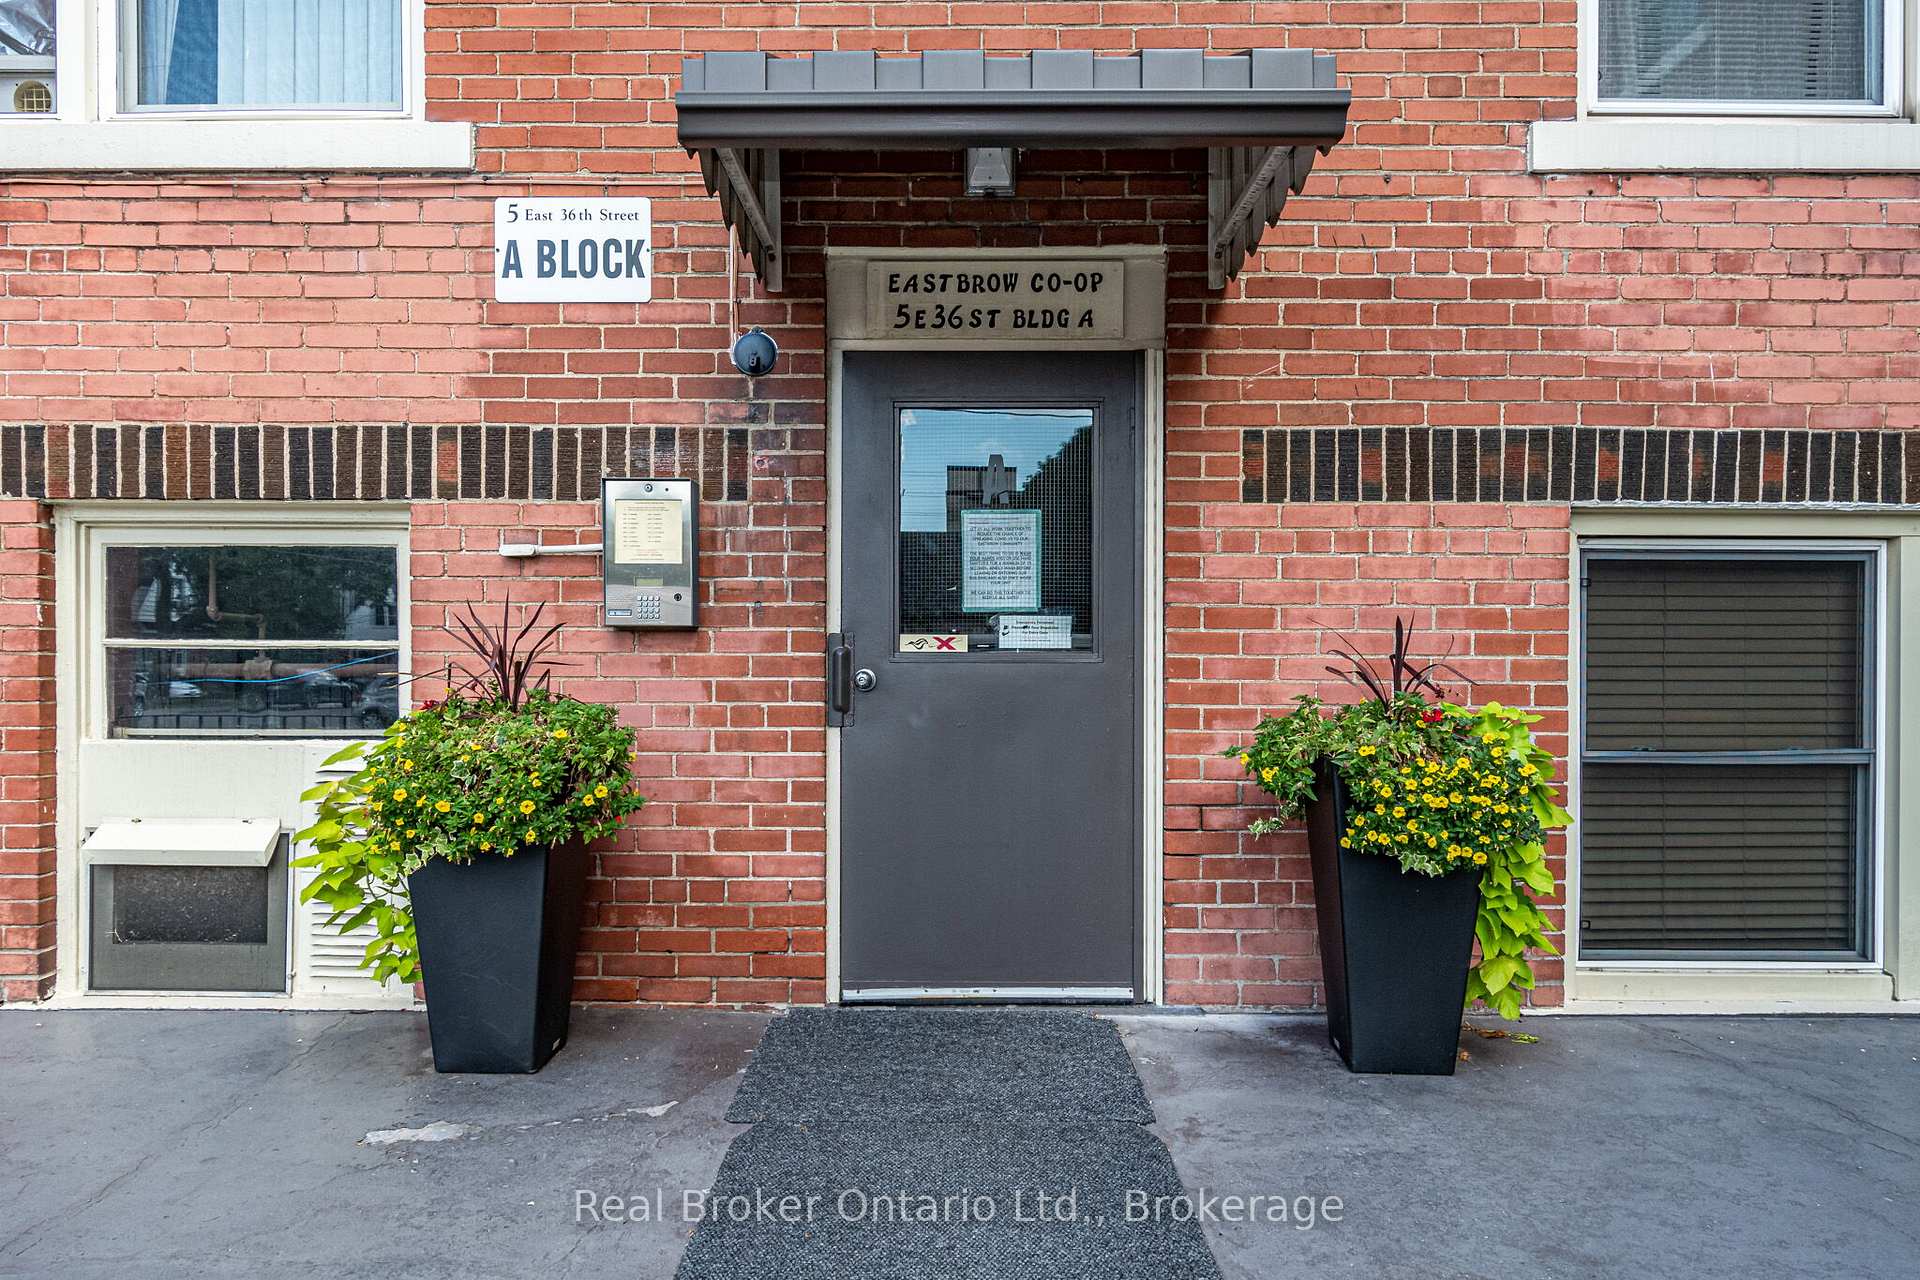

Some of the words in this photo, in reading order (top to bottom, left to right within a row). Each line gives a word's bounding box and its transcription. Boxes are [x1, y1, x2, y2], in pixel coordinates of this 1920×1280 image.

[507, 204, 519, 223] 5
[525, 208, 552, 221] East
[561, 208, 592, 221] 36th
[600, 208, 639, 221] Street
[501, 239, 523, 279] A
[537, 238, 645, 279] BLOCK
[888, 273, 1019, 293] EASTBROW
[1030, 272, 1104, 293] CO-OP
[1012, 309, 1070, 329] BLDG
[1077, 309, 1094, 328] A
